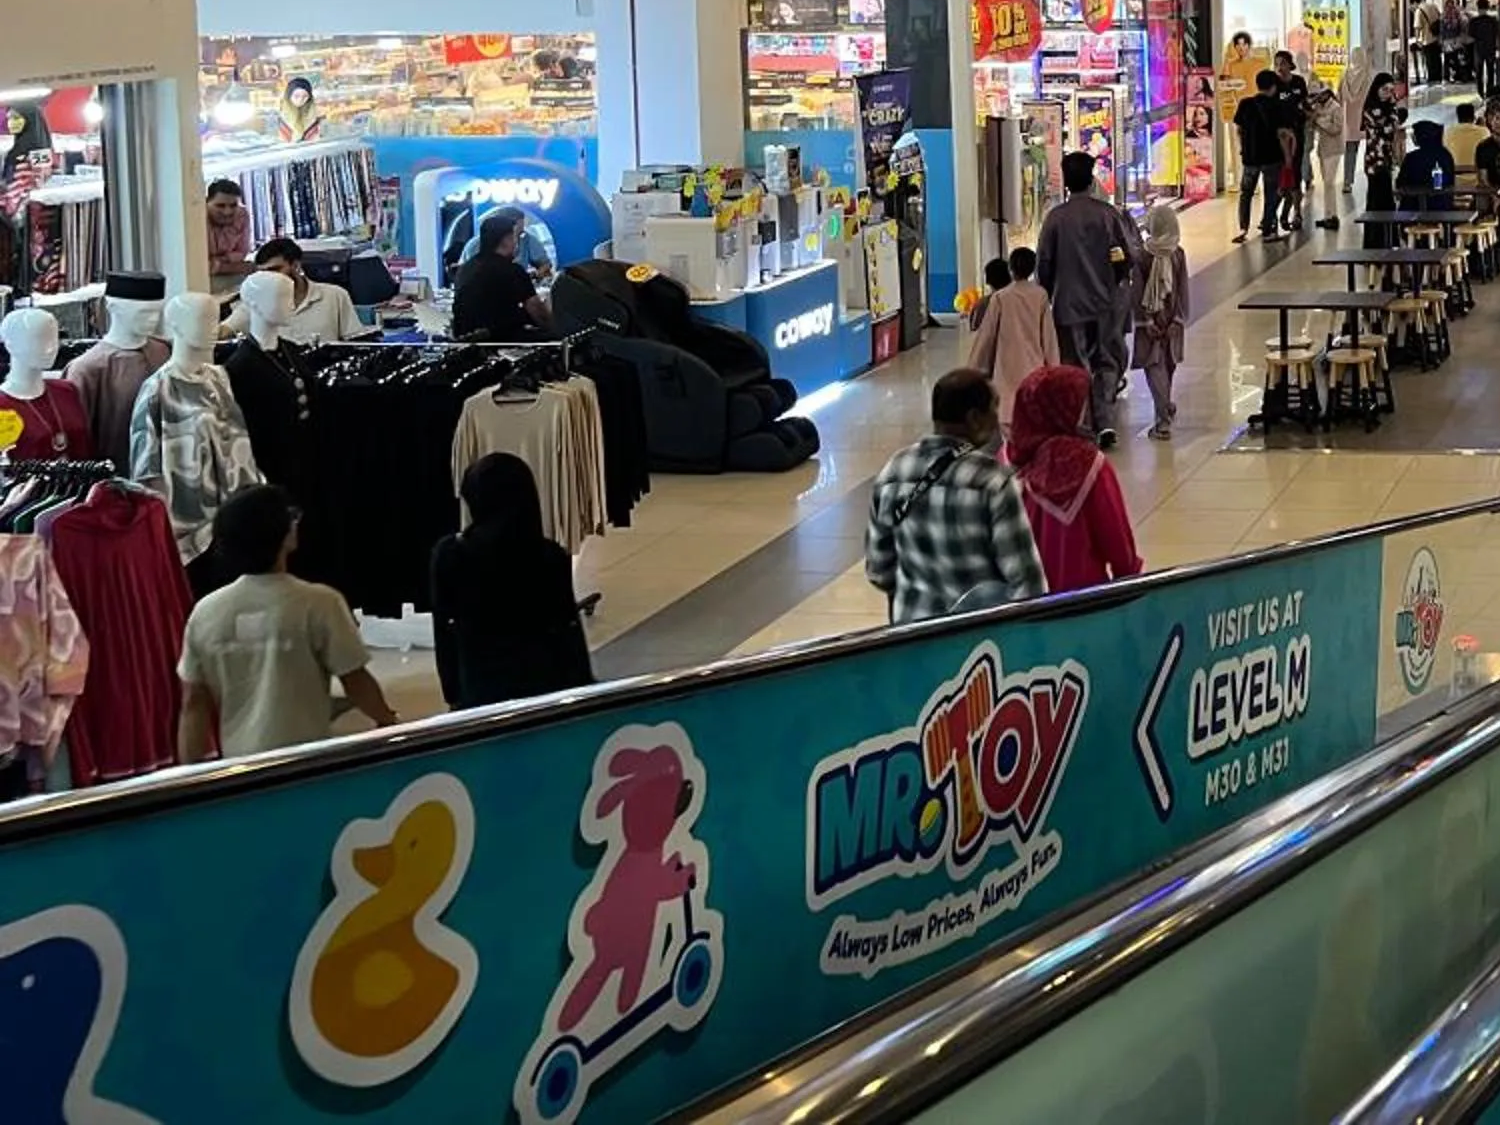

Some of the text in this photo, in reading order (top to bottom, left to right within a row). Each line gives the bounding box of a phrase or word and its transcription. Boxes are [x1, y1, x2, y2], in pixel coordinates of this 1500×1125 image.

[775, 303, 834, 349] coway
[1207, 590, 1304, 651] VISIT US AT
[1190, 639, 1309, 751] LEVEL M
[921, 653, 1085, 867] TOY
[1204, 737, 1290, 807] M30 & M31
[828, 930, 888, 964] Always
[891, 924, 923, 952] Low
[927, 902, 976, 940] Prices,
[980, 863, 1028, 911] Always
